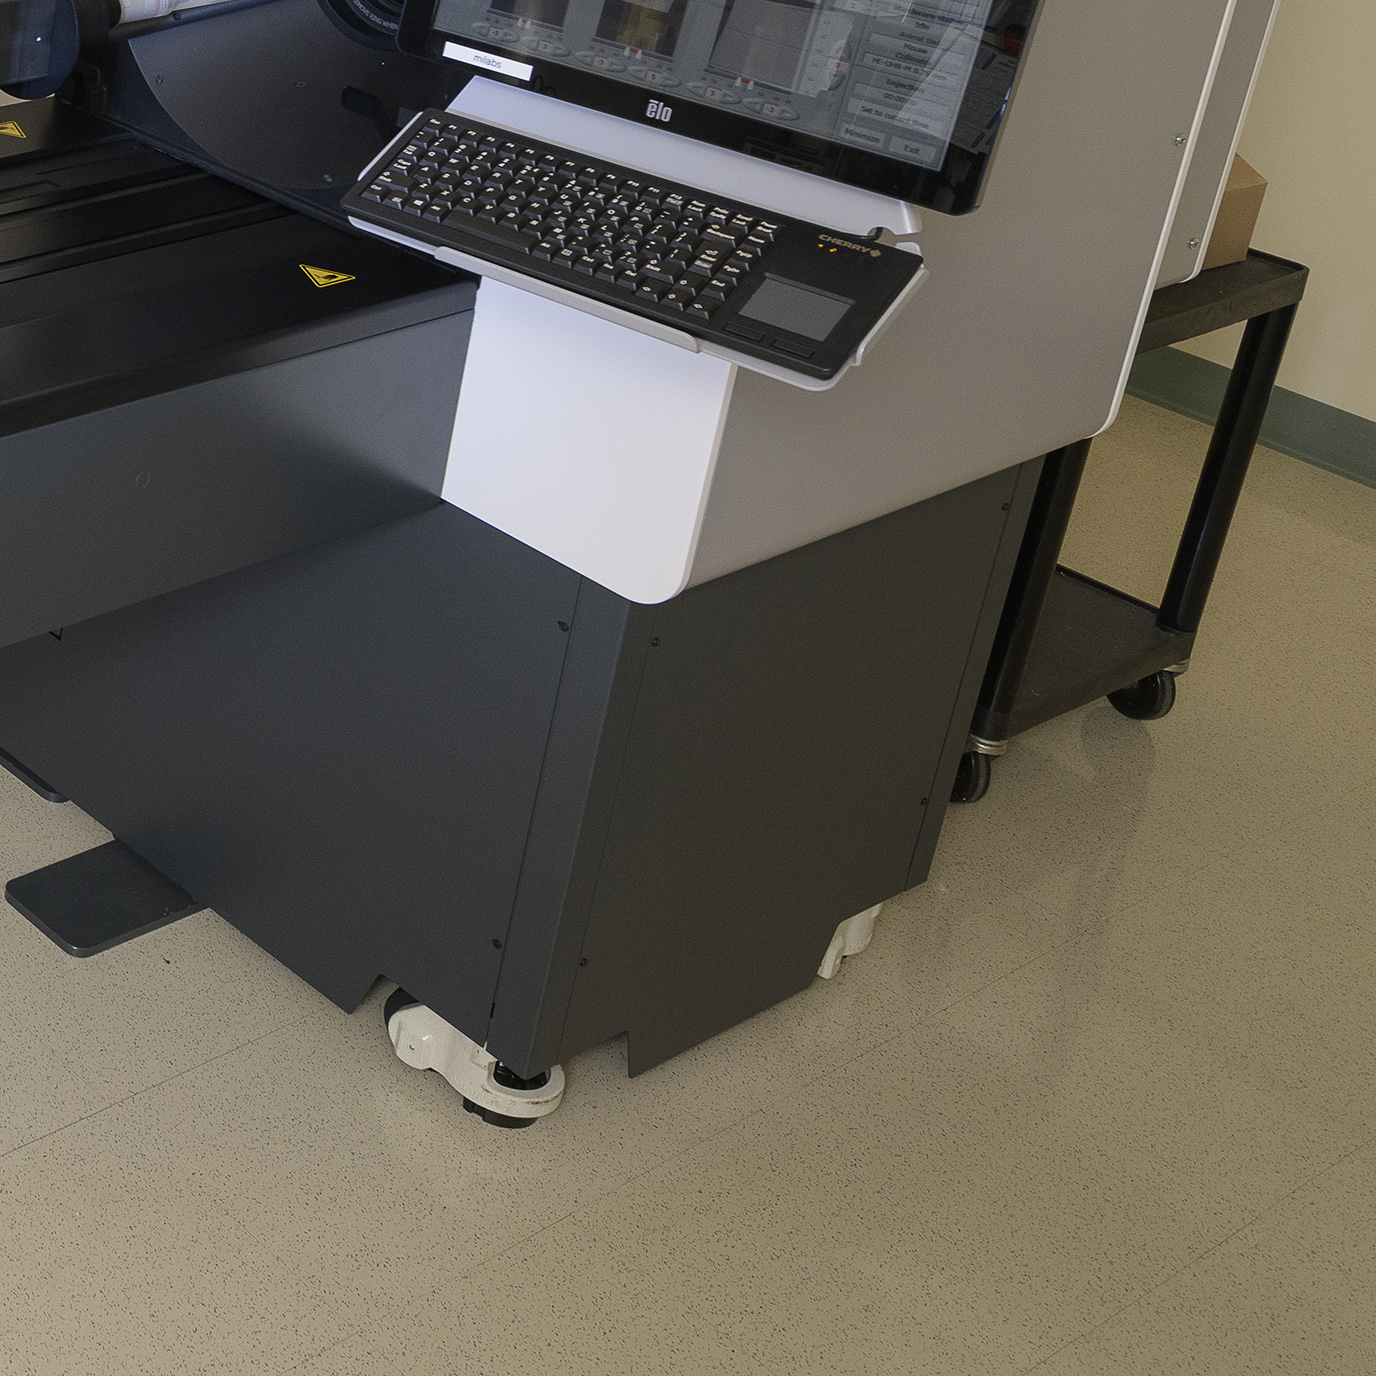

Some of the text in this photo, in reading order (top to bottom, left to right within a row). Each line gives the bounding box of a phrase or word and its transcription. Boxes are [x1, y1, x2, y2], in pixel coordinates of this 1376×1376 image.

[903, 42, 928, 54] Mouse
[473, 51, 503, 70] milabs
[844, 127, 882, 145] Minimize
[903, 144, 921, 156] Exit
[817, 233, 871, 254] CHERRY
